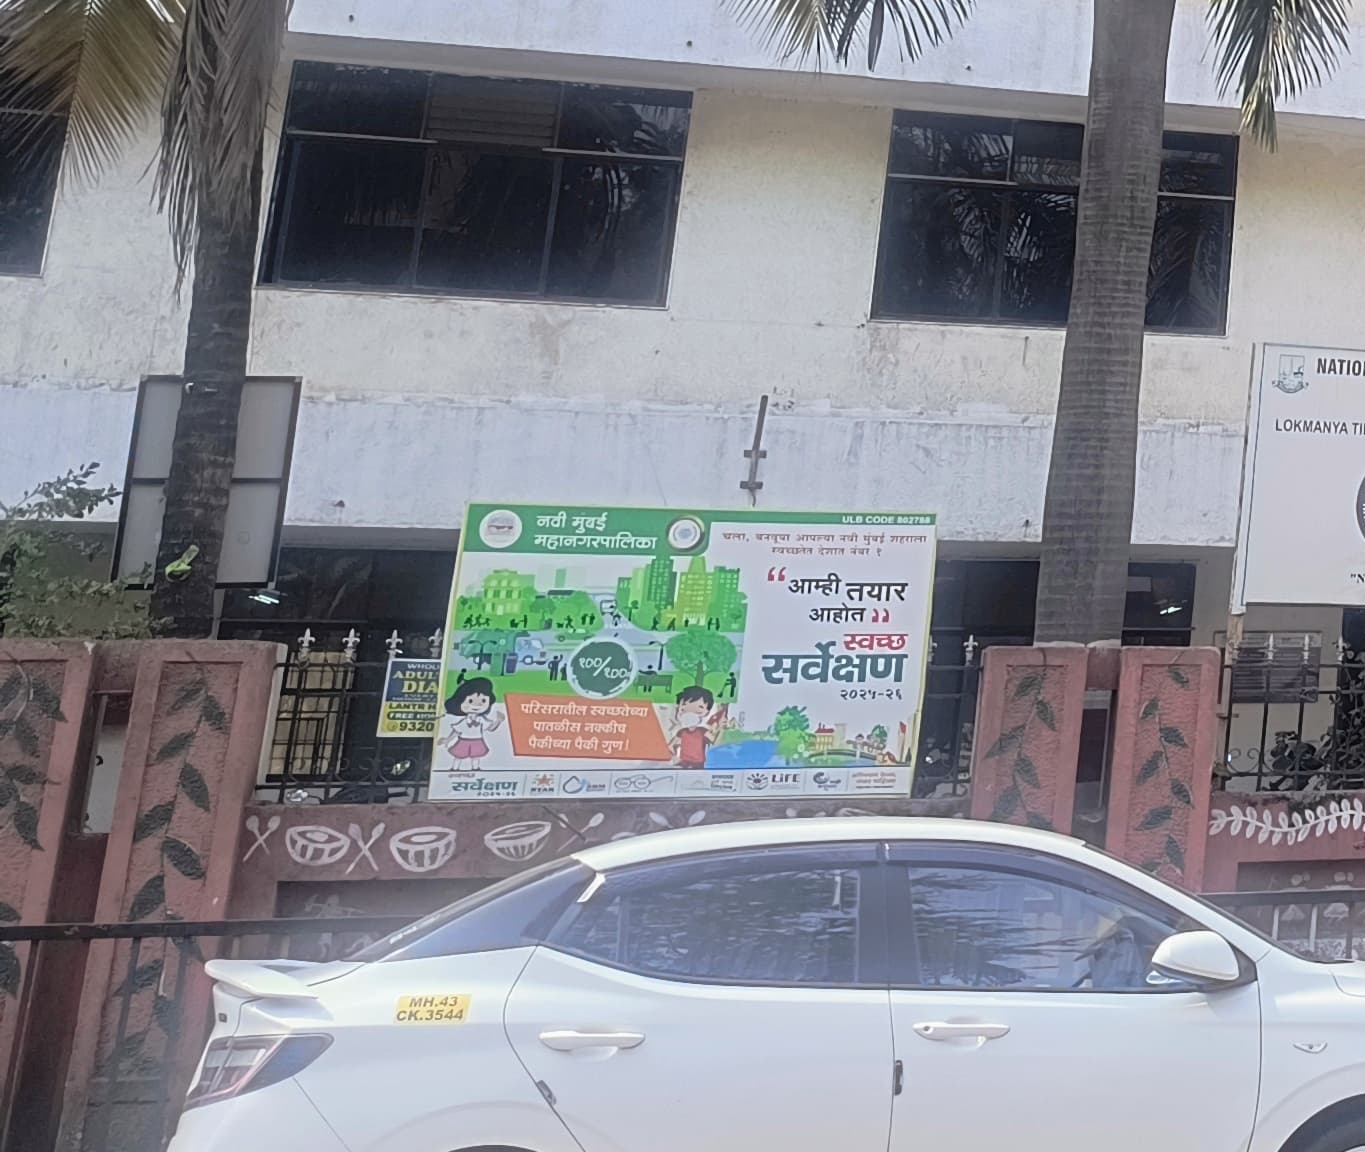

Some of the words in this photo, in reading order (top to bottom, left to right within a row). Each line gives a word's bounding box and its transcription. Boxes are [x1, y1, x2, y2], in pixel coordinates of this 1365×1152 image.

[1275, 418, 1349, 435] LOKMANYA
[536, 511, 567, 528] नवी
[572, 511, 608, 534] मुंबई
[842, 515, 864, 524] ULB
[866, 516, 895, 524] CODE
[534, 532, 658, 550] महानगरपालिका
[846, 583, 908, 601] तयार
[843, 634, 908, 651] स्वच्छ
[762, 641, 908, 684] सर्वेक्षण
[521, 700, 586, 715] परिसरातील
[409, 996, 458, 1007] MH.43
[396, 1009, 463, 1021] CK.3544
